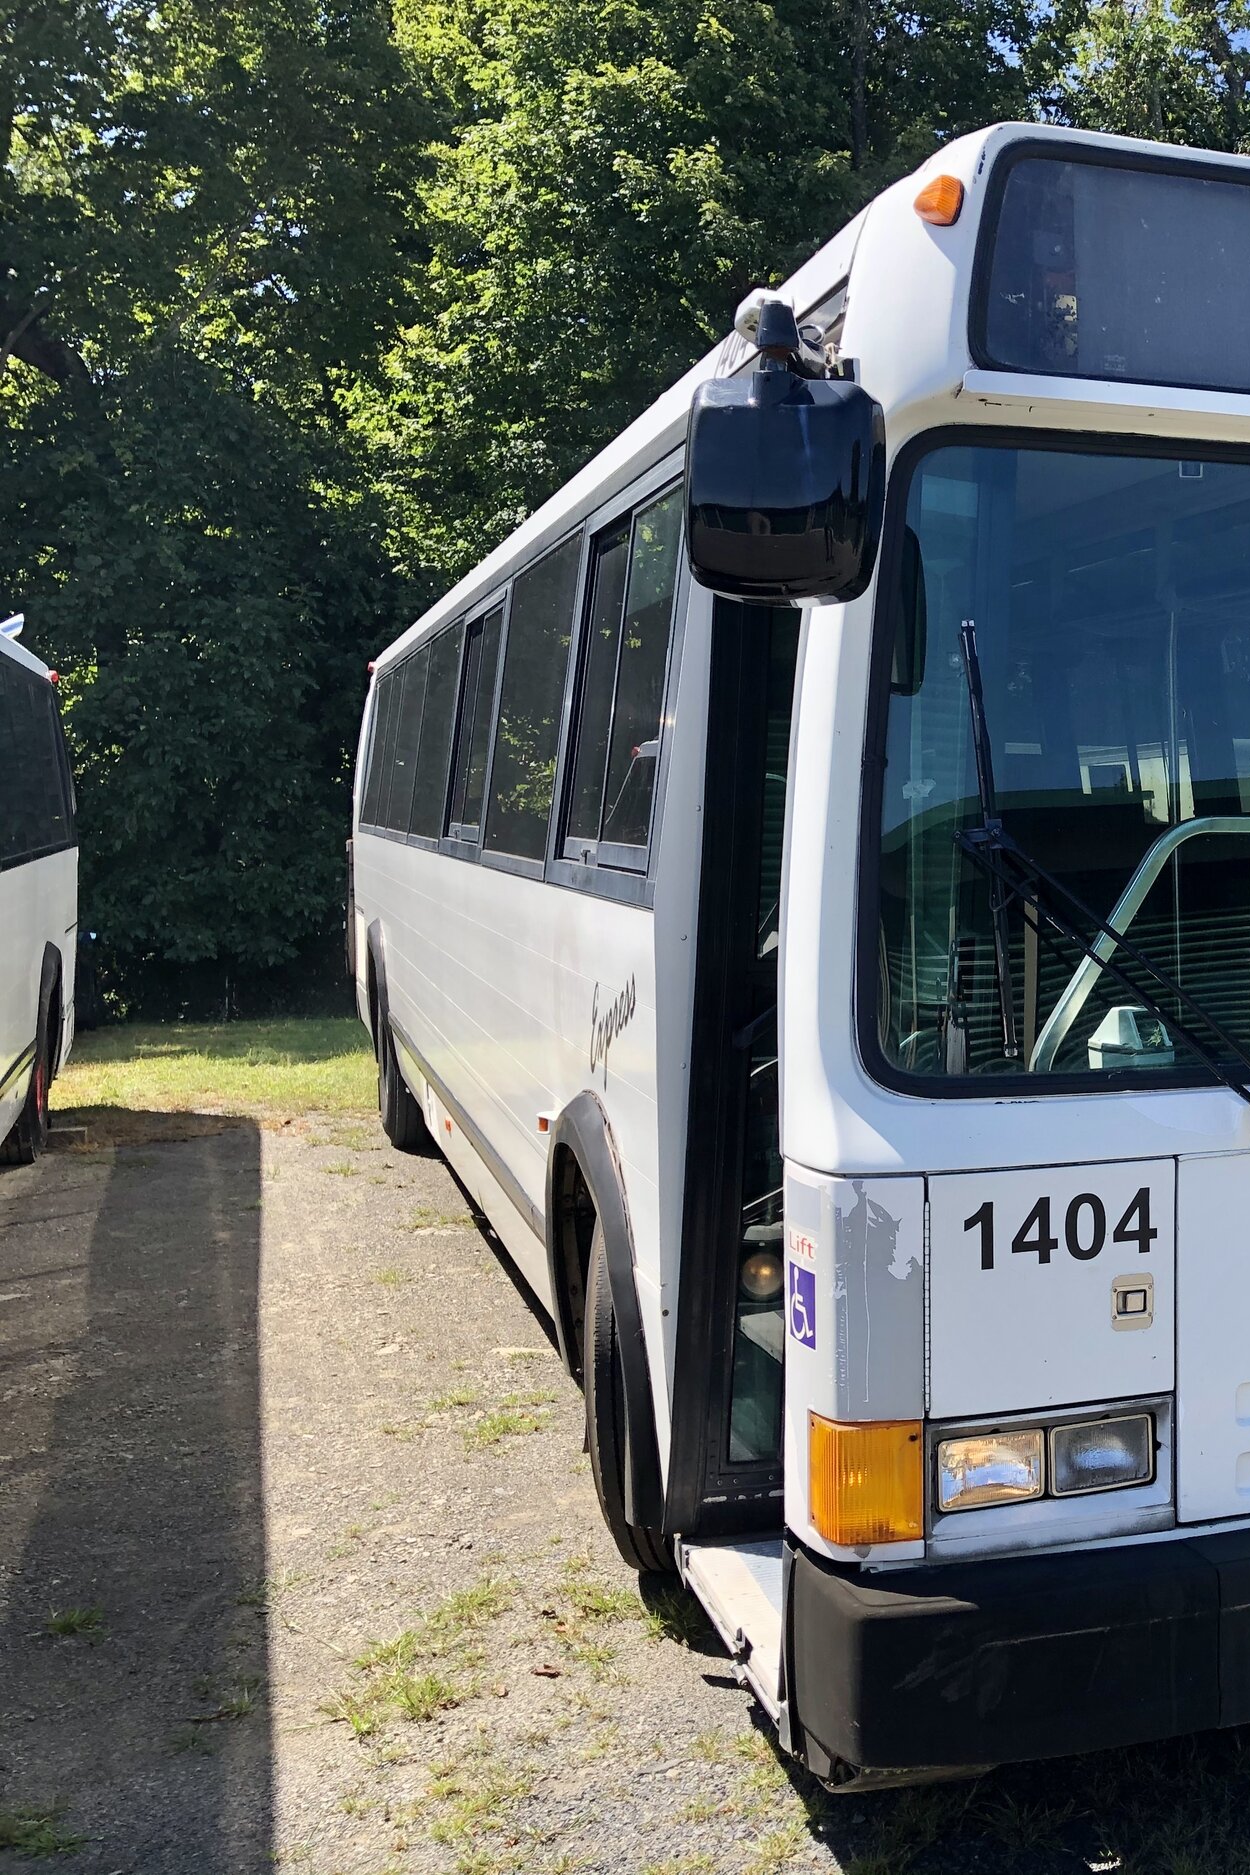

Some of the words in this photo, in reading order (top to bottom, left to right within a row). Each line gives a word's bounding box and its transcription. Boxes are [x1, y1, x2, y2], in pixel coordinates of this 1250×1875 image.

[591, 972, 636, 1093] Express
[789, 1231, 815, 1259] Lift
[963, 1187, 1157, 1270] 1404
